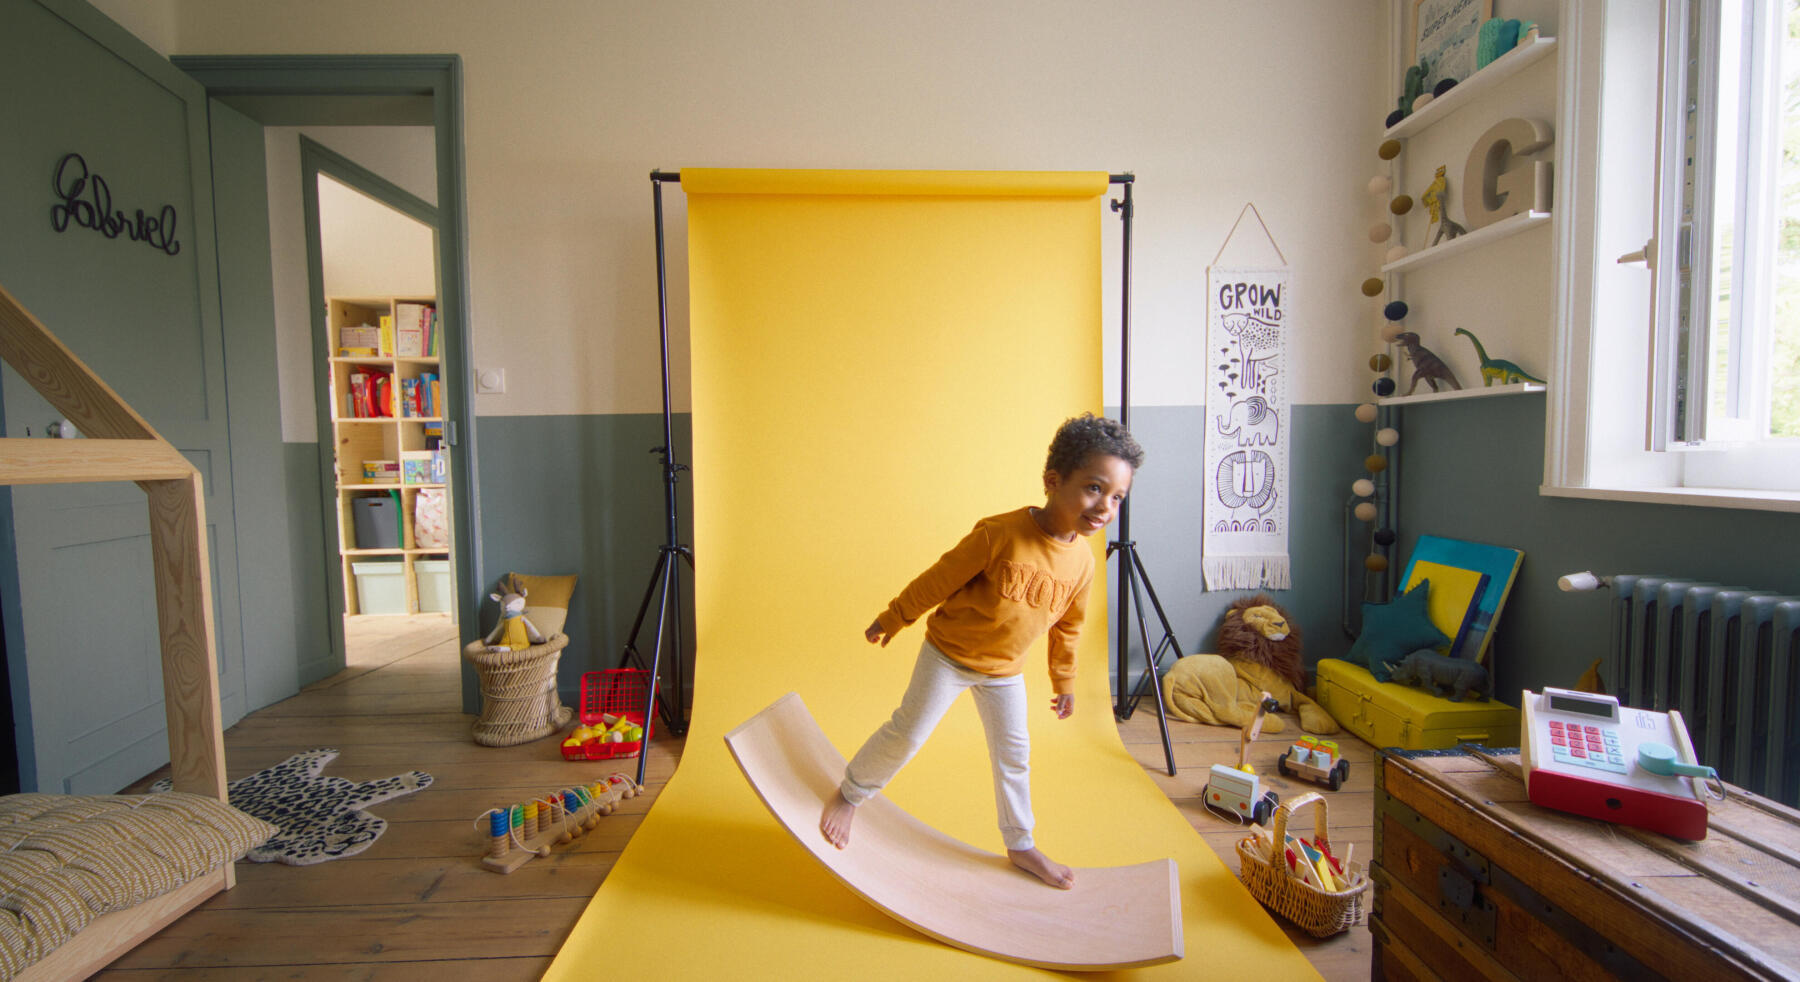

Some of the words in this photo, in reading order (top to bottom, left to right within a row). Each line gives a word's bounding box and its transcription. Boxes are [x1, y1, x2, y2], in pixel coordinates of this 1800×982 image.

[52, 153, 180, 256] Gabriel
[1463, 117, 1554, 231] G
[1219, 282, 1282, 310] GROW
[1253, 307, 1282, 321] WILD
